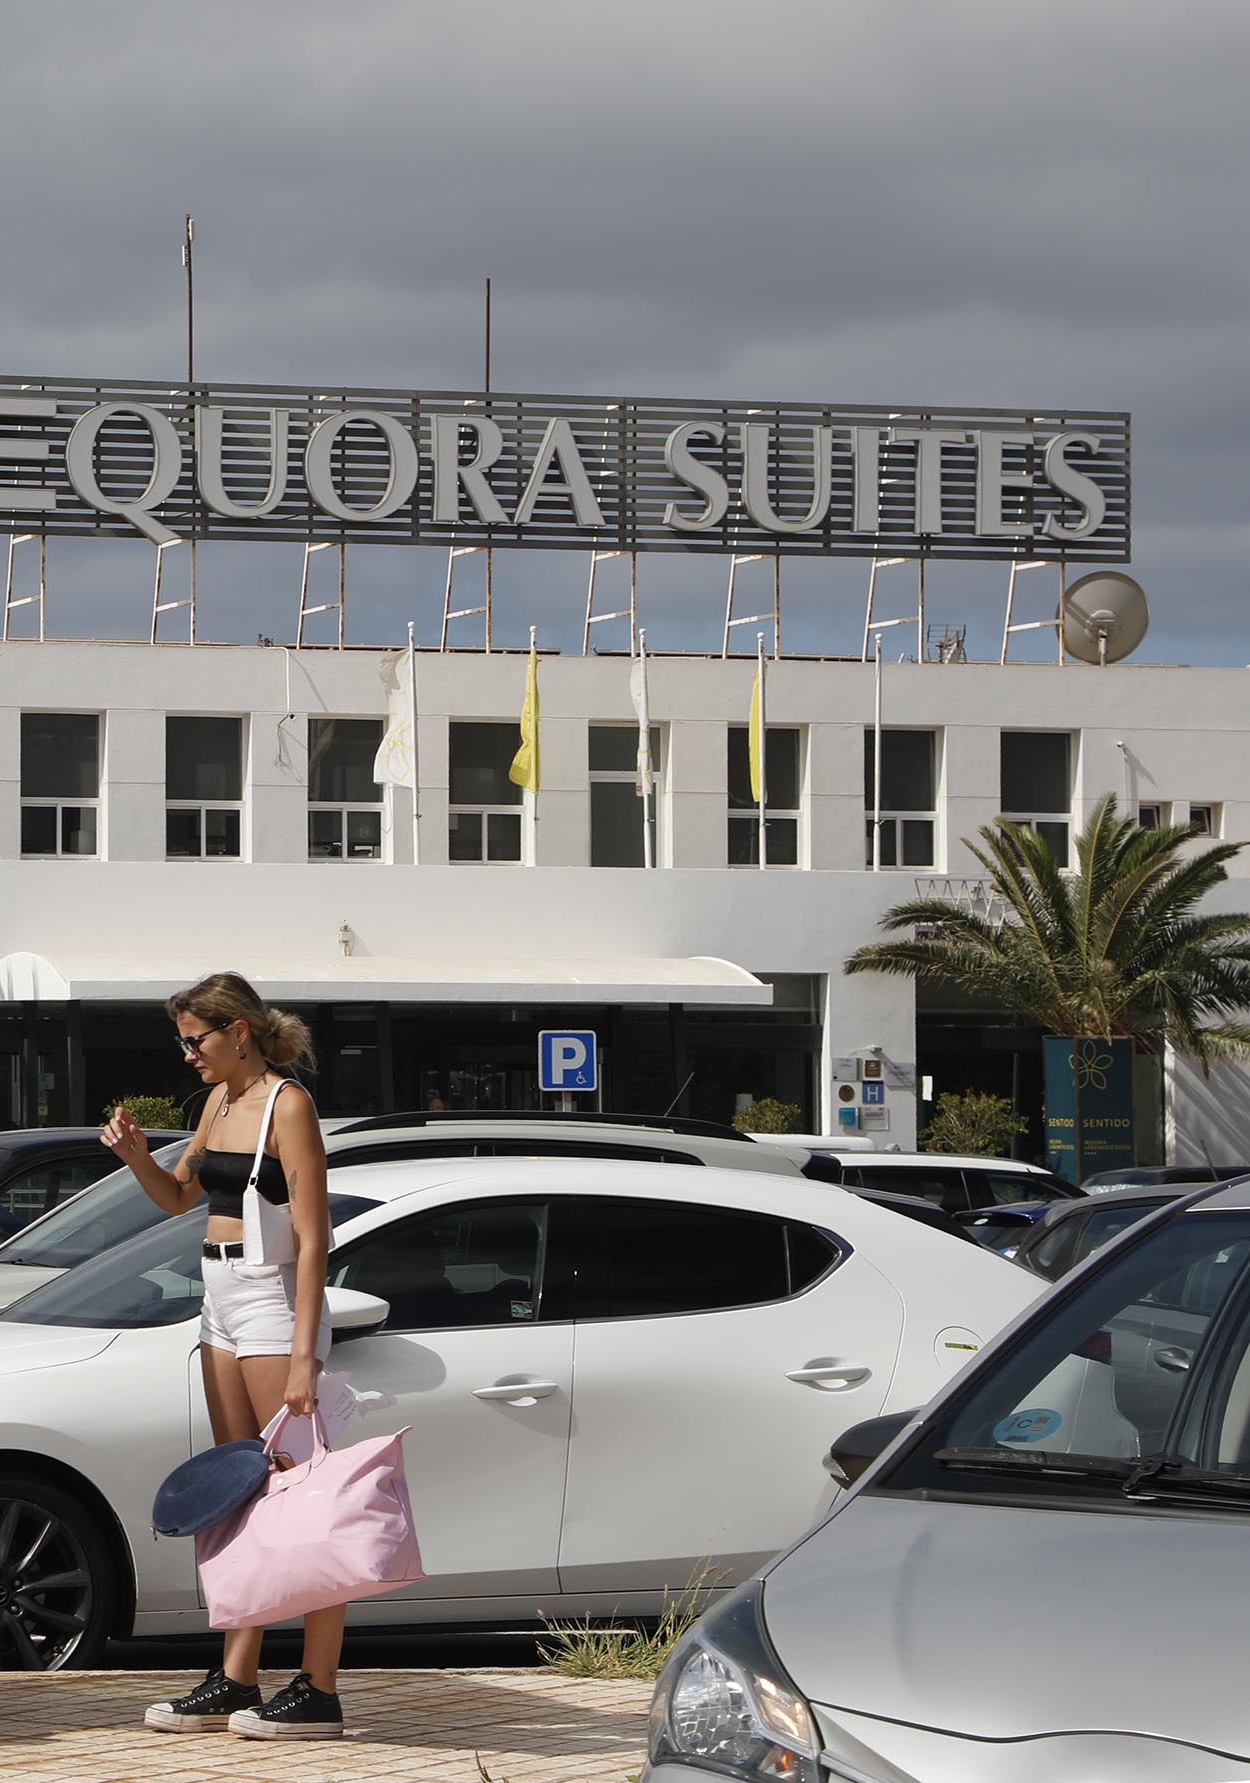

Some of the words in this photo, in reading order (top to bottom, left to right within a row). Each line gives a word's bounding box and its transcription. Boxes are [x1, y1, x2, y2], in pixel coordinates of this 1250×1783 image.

[662, 420, 1107, 541] SUITES
[551, 1037, 587, 1085] P
[867, 1086, 879, 1102] H
[1048, 1118, 1075, 1128] SENTIDO
[1083, 1118, 1131, 1128] SENTIDO
[1017, 1419, 1033, 1429] C
